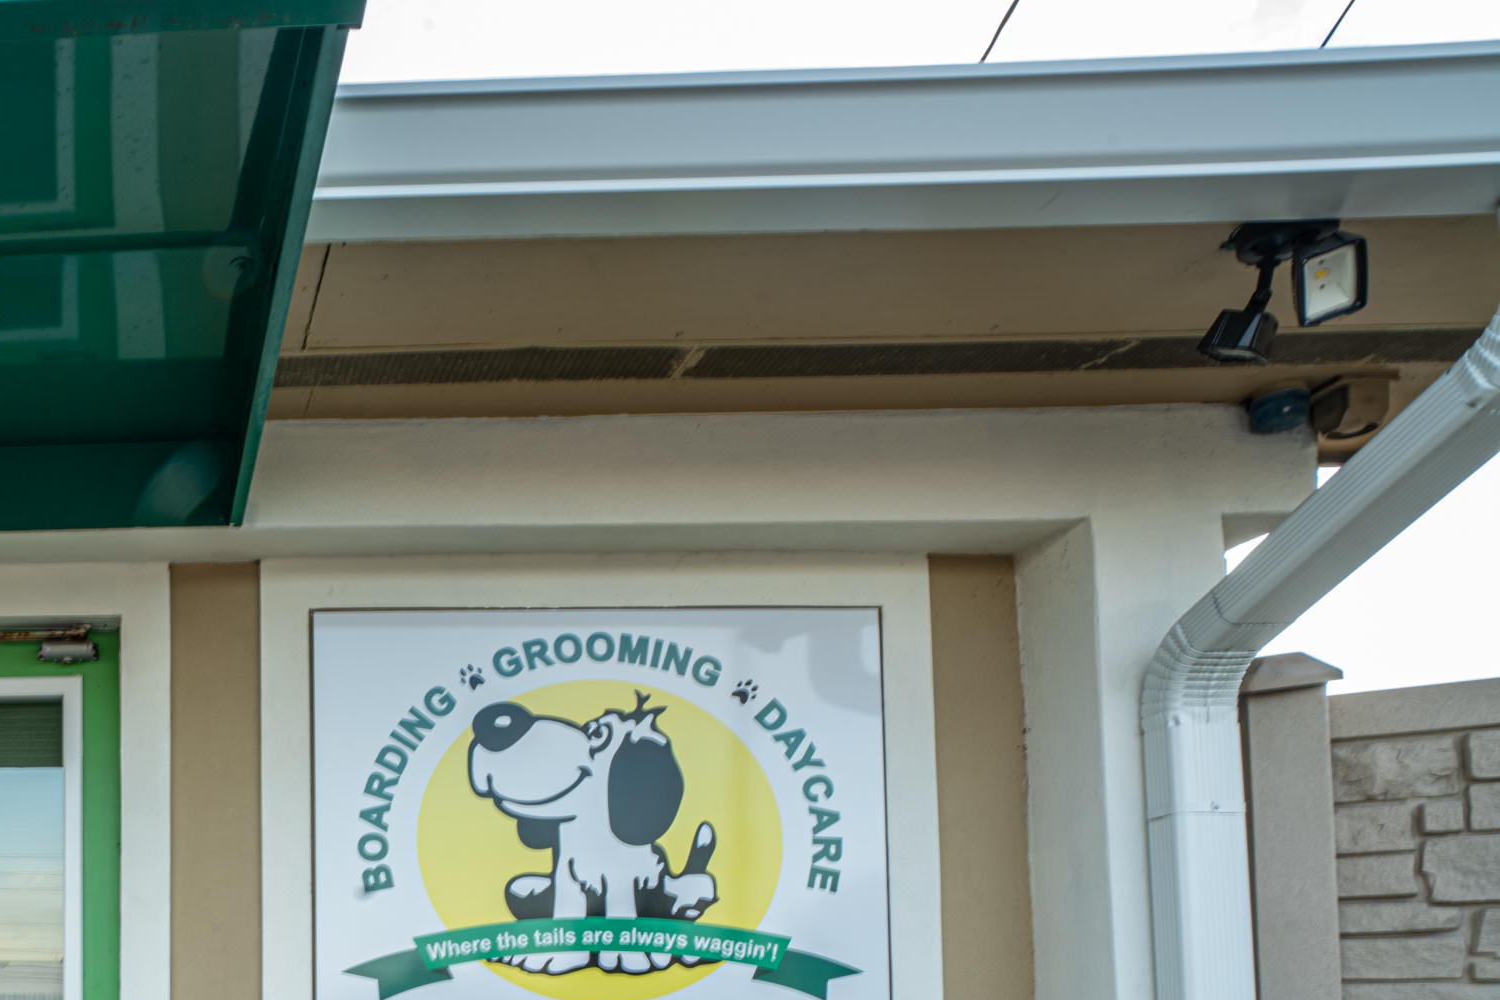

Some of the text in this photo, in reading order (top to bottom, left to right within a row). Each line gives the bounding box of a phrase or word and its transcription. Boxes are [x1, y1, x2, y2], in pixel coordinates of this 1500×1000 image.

[356, 631, 844, 894] BOARDING GROOMING DAYCARE
[425, 936, 493, 962] Where
[497, 930, 529, 949] the
[534, 926, 577, 946] tails
[581, 928, 615, 945] are
[618, 926, 689, 950] always
